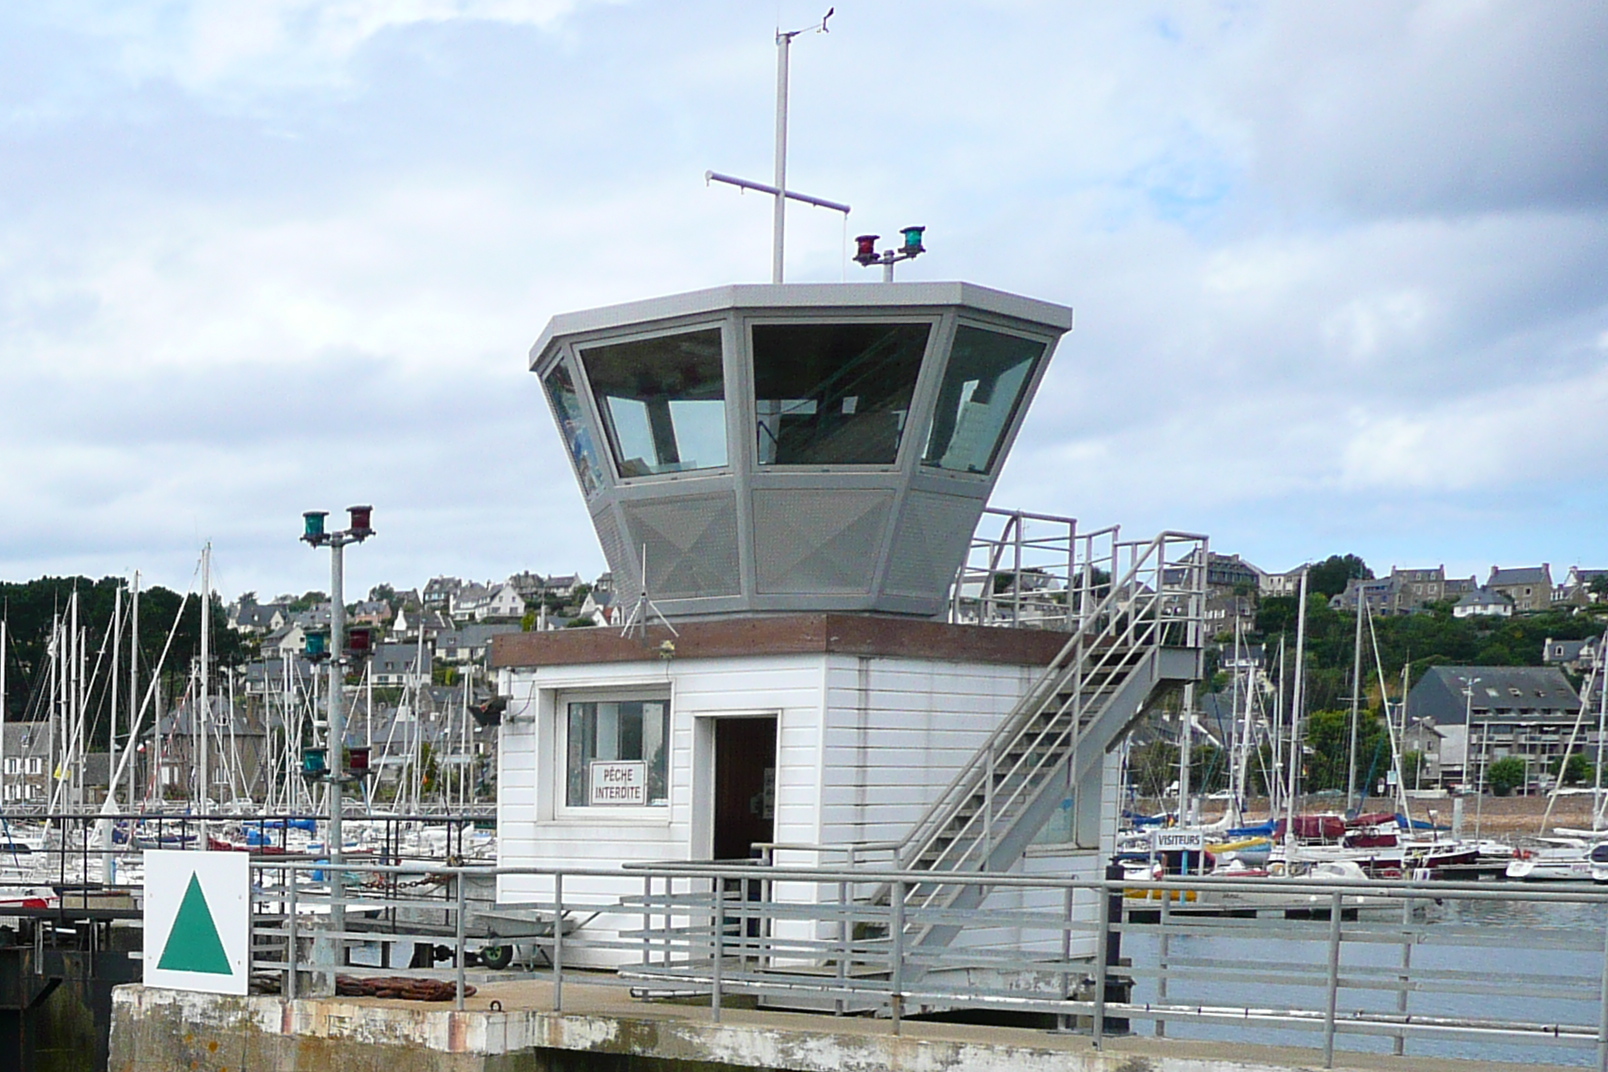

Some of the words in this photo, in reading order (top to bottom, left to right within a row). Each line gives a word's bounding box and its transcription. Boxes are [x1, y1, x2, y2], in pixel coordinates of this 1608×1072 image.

[604, 766, 633, 781] PÊCHE
[595, 786, 641, 799] INTERDITE
[1158, 834, 1200, 845] VISITEURS
